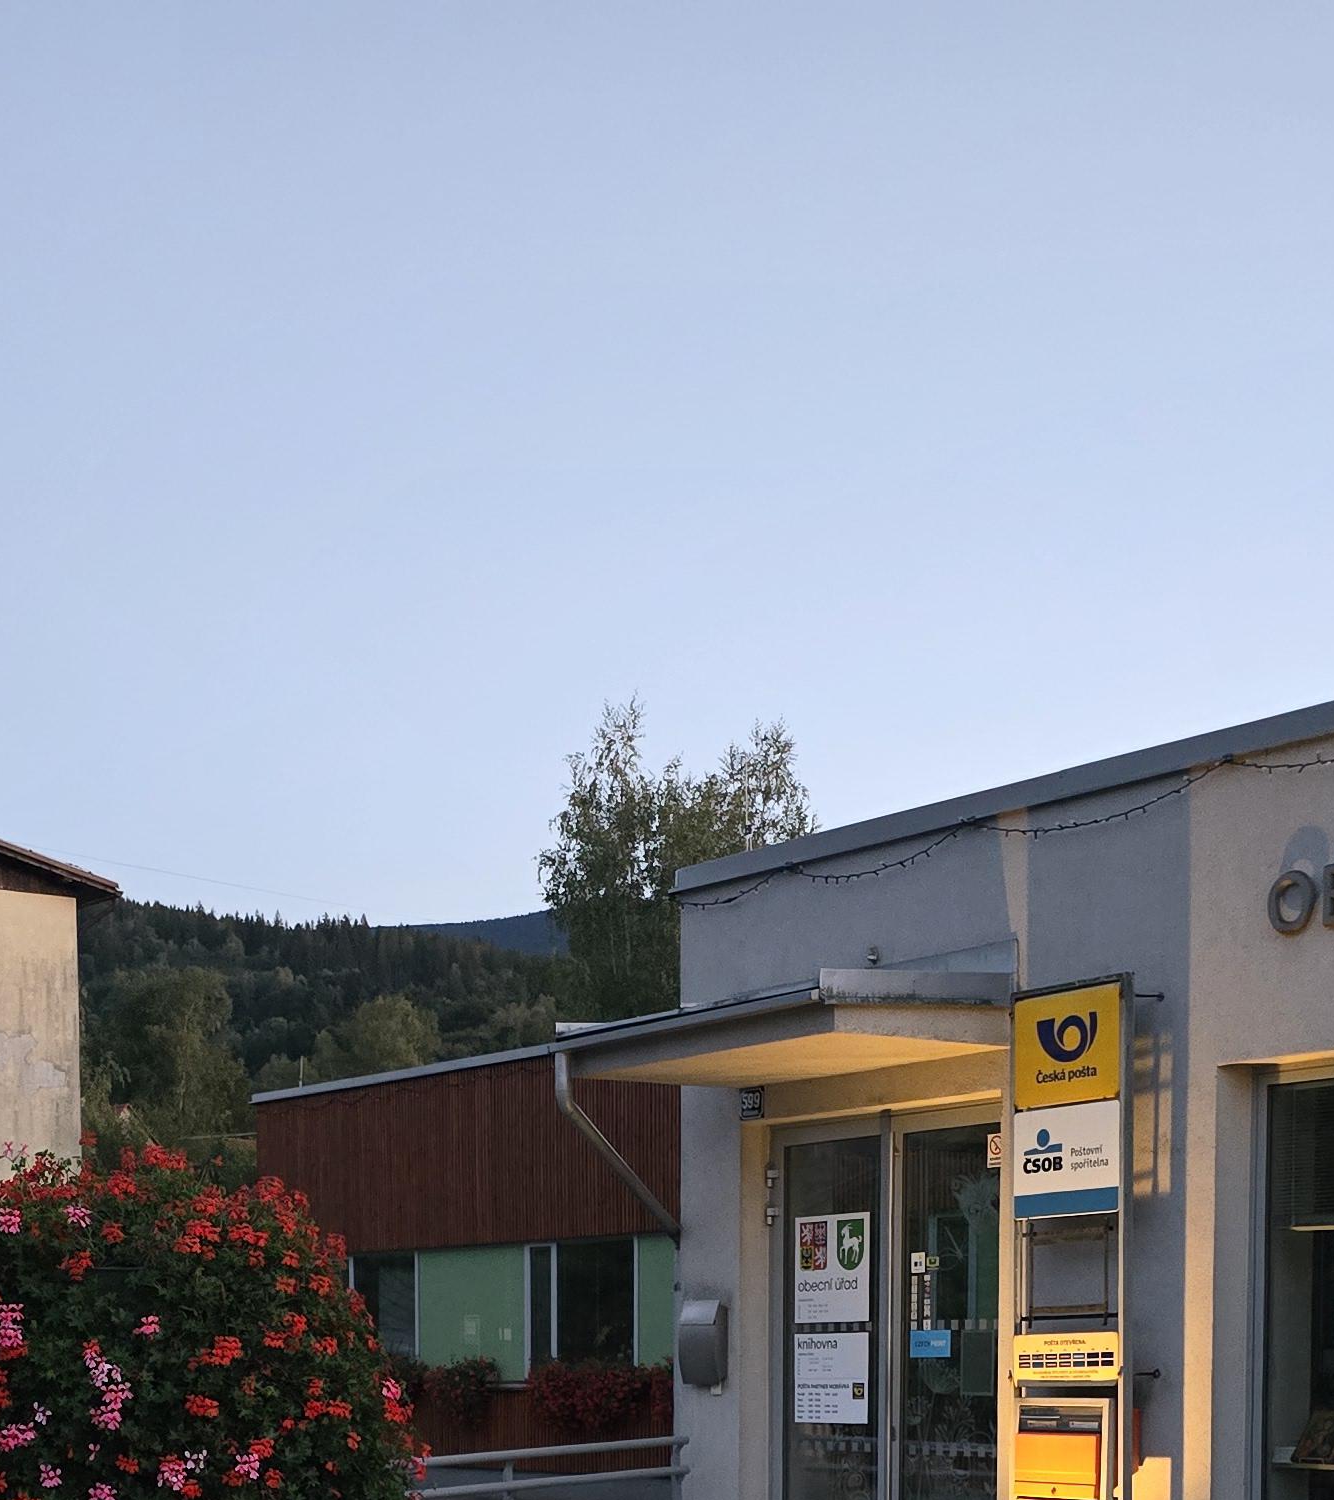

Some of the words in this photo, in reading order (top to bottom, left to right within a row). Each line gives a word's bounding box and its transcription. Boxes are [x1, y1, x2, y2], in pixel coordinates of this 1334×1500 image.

[1036, 1069, 1066, 1084] Česká
[1067, 1065, 1098, 1082] pošta
[1070, 1144, 1104, 1157] Poštovní
[1023, 1156, 1064, 1175] ČSOB
[1070, 1157, 1109, 1172] spořitelna
[797, 1278, 833, 1293] obecní
[797, 1337, 839, 1351] knihovna
